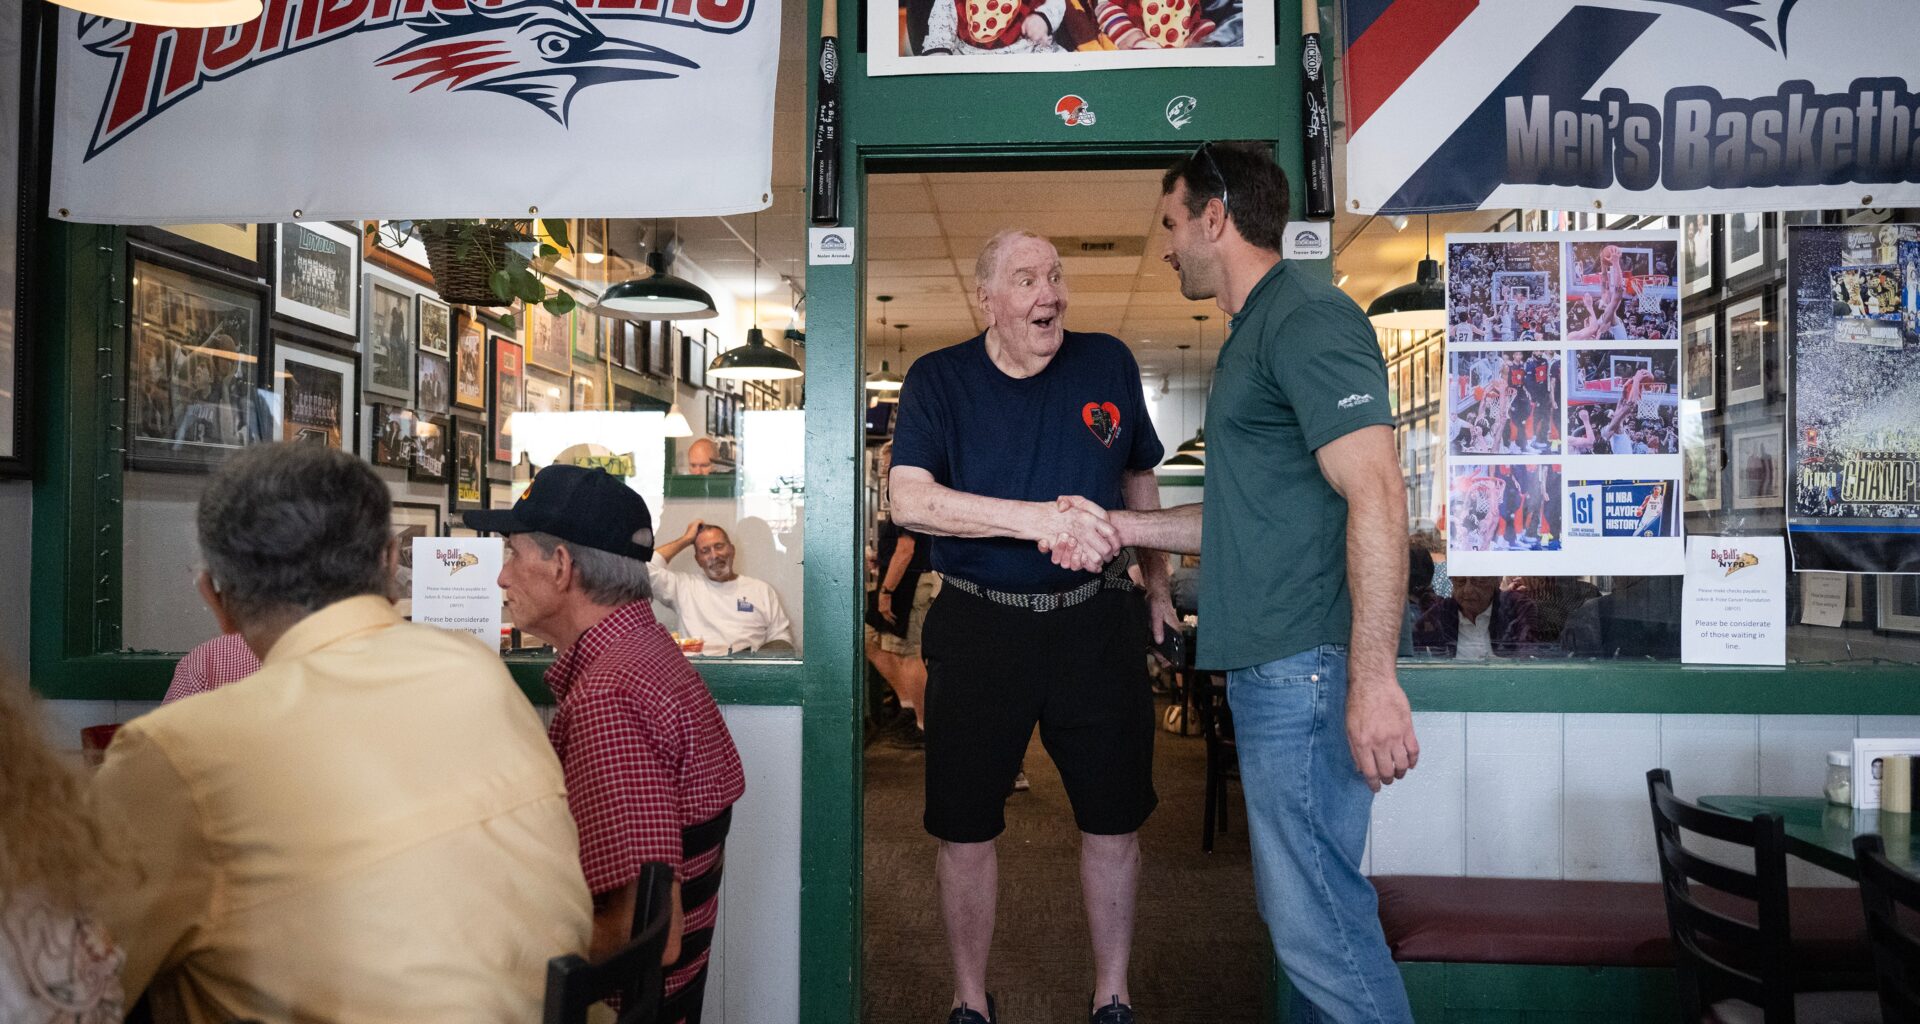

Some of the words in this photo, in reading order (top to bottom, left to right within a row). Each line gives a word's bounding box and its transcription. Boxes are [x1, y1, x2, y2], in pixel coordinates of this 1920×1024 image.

[824, 42, 835, 84] HICKORY
[1306, 38, 1319, 80] HICKORY
[1505, 95, 1651, 181] Men's
[1674, 90, 1920, 181] Basketb
[298, 227, 337, 255] LOYOLA
[1458, 333, 1469, 342] 27
[1606, 492, 1615, 503] IN
[1615, 492, 1632, 503] NBA
[1570, 492, 1594, 525] 1st
[1605, 519, 1640, 530] HISTORY
[436, 549, 447, 561] Big
[447, 548, 462, 559] Bill's
[1711, 549, 1723, 562] Big
[1723, 548, 1740, 559] Bill's
[1695, 619, 1718, 627] Please
[1731, 632, 1757, 640] waiting
